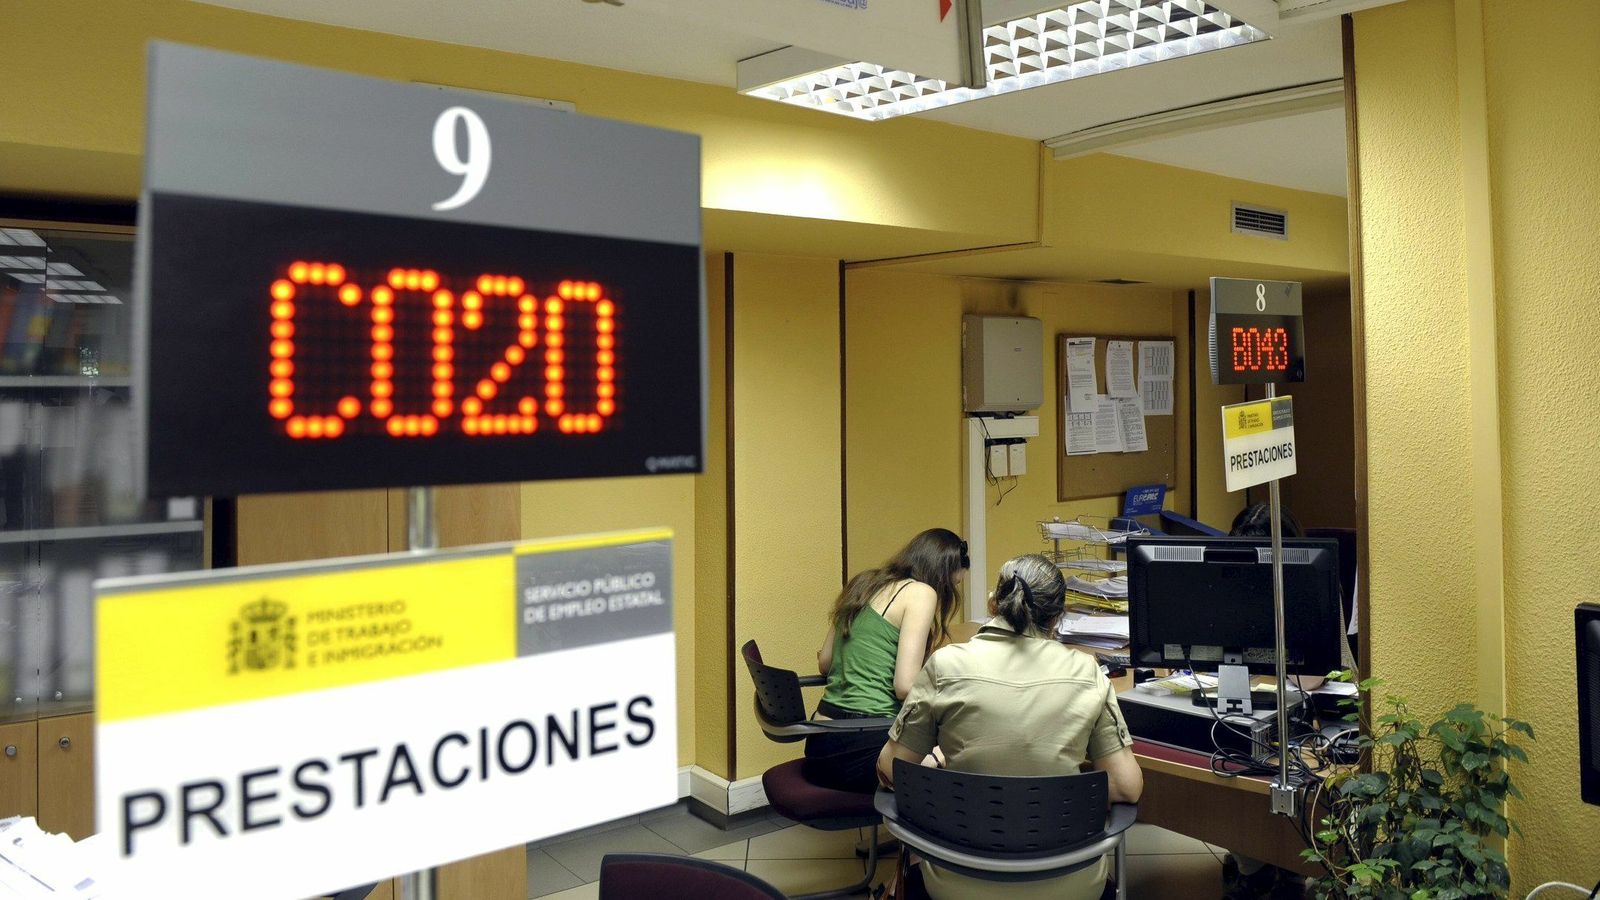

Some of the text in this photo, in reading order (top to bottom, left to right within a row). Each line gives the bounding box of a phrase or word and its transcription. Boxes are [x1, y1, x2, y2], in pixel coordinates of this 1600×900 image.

[432, 106, 492, 211] 9
[1256, 283, 1266, 312] 8
[269, 260, 615, 439] C020
[1232, 327, 1288, 371] B043
[1230, 442, 1293, 472] PRESTACIONES
[524, 580, 593, 605] SERVICIO
[524, 589, 664, 624] DE EMPLEO ESTATAL
[306, 600, 406, 623] MINISTERIO
[307, 619, 412, 647] DE TRABAJO
[307, 636, 443, 667] E INMIGRACIÓN
[120, 695, 656, 858] PRESTACIONES
